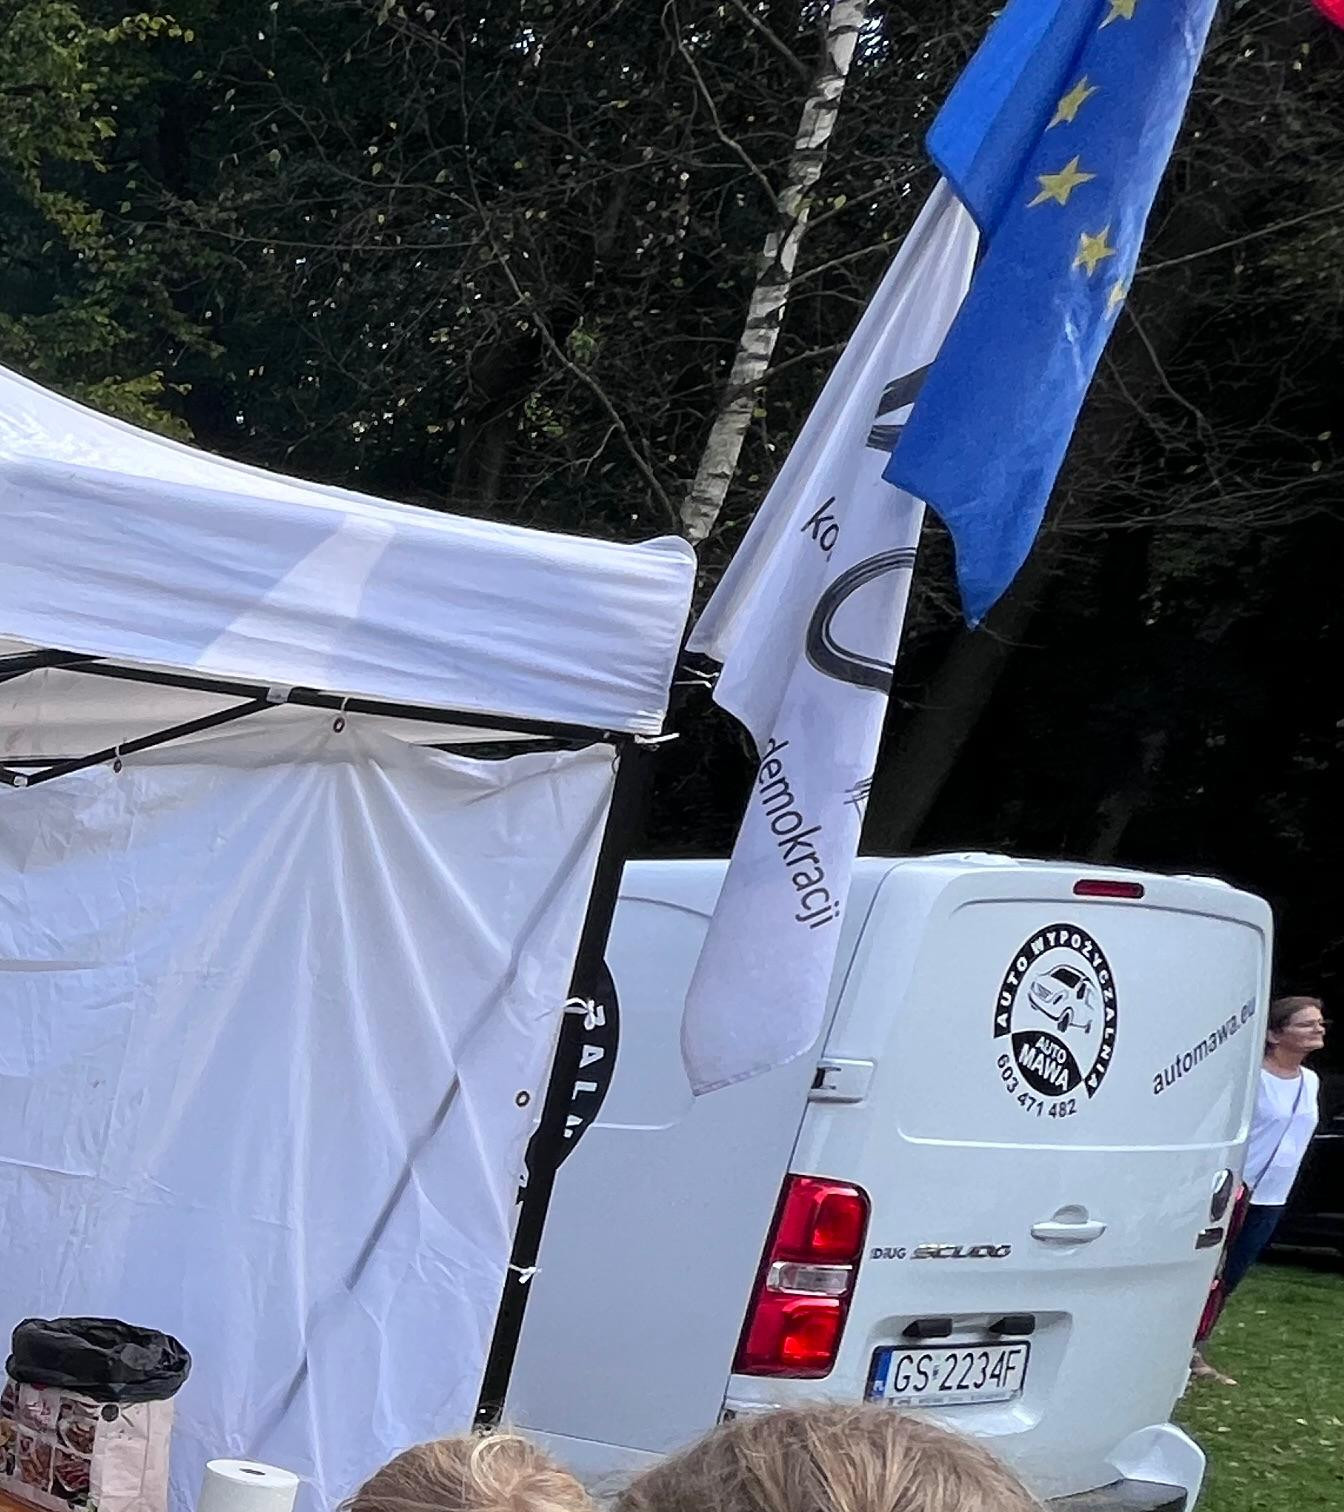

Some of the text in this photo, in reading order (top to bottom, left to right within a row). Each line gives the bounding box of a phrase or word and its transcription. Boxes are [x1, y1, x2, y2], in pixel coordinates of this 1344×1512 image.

[997, 930, 1116, 1088] AUTO WYPOŻYCZALNIA
[1018, 1043, 1070, 1091] MAWA
[1035, 1036, 1067, 1063] AUTO
[1153, 996, 1256, 1095] automawa.eu
[997, 1054, 1077, 1119] 603 471 482
[894, 1353, 933, 1392] GS
[938, 1349, 1022, 1391] 2234F
